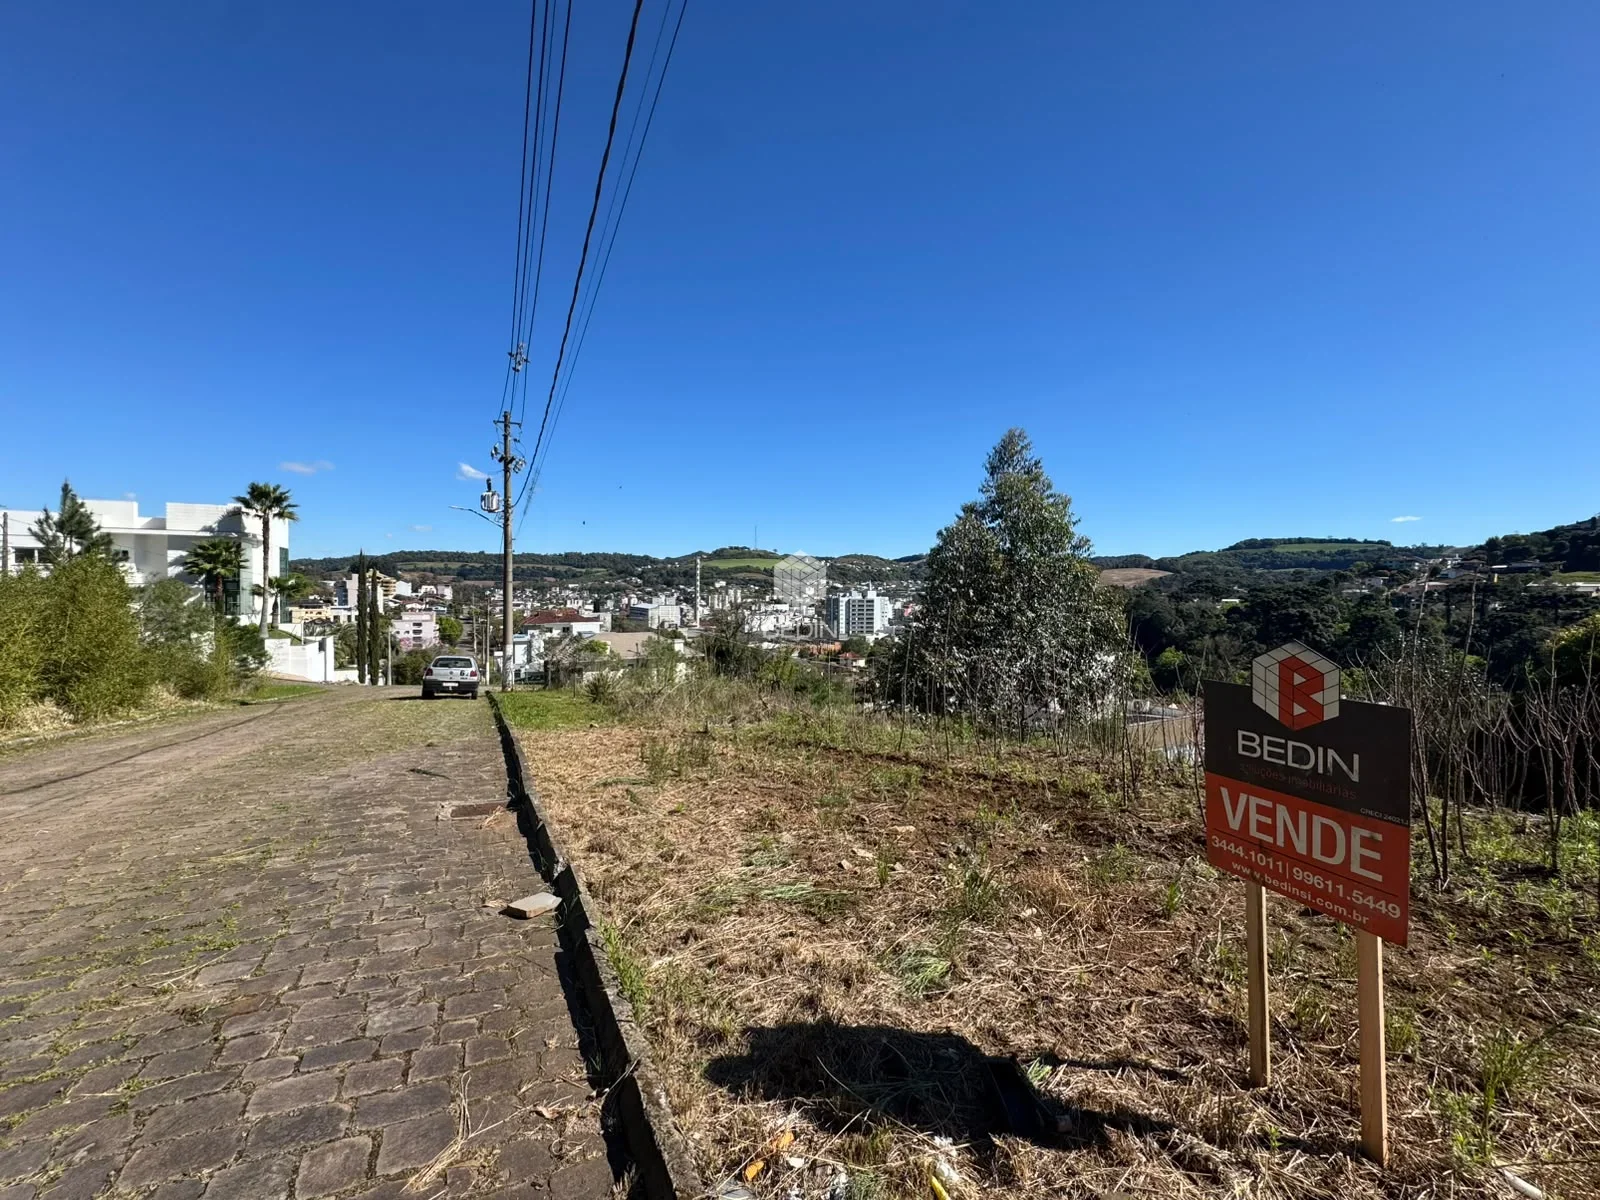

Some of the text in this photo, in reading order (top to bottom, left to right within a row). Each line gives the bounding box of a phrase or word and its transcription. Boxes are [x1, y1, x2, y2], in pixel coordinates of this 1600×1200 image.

[1237, 729, 1360, 783] BEDIN
[1219, 785, 1384, 883] VENDE
[1360, 807, 1383, 818] CRECI
[1231, 861, 1370, 925] www.bedinsi.com.br
